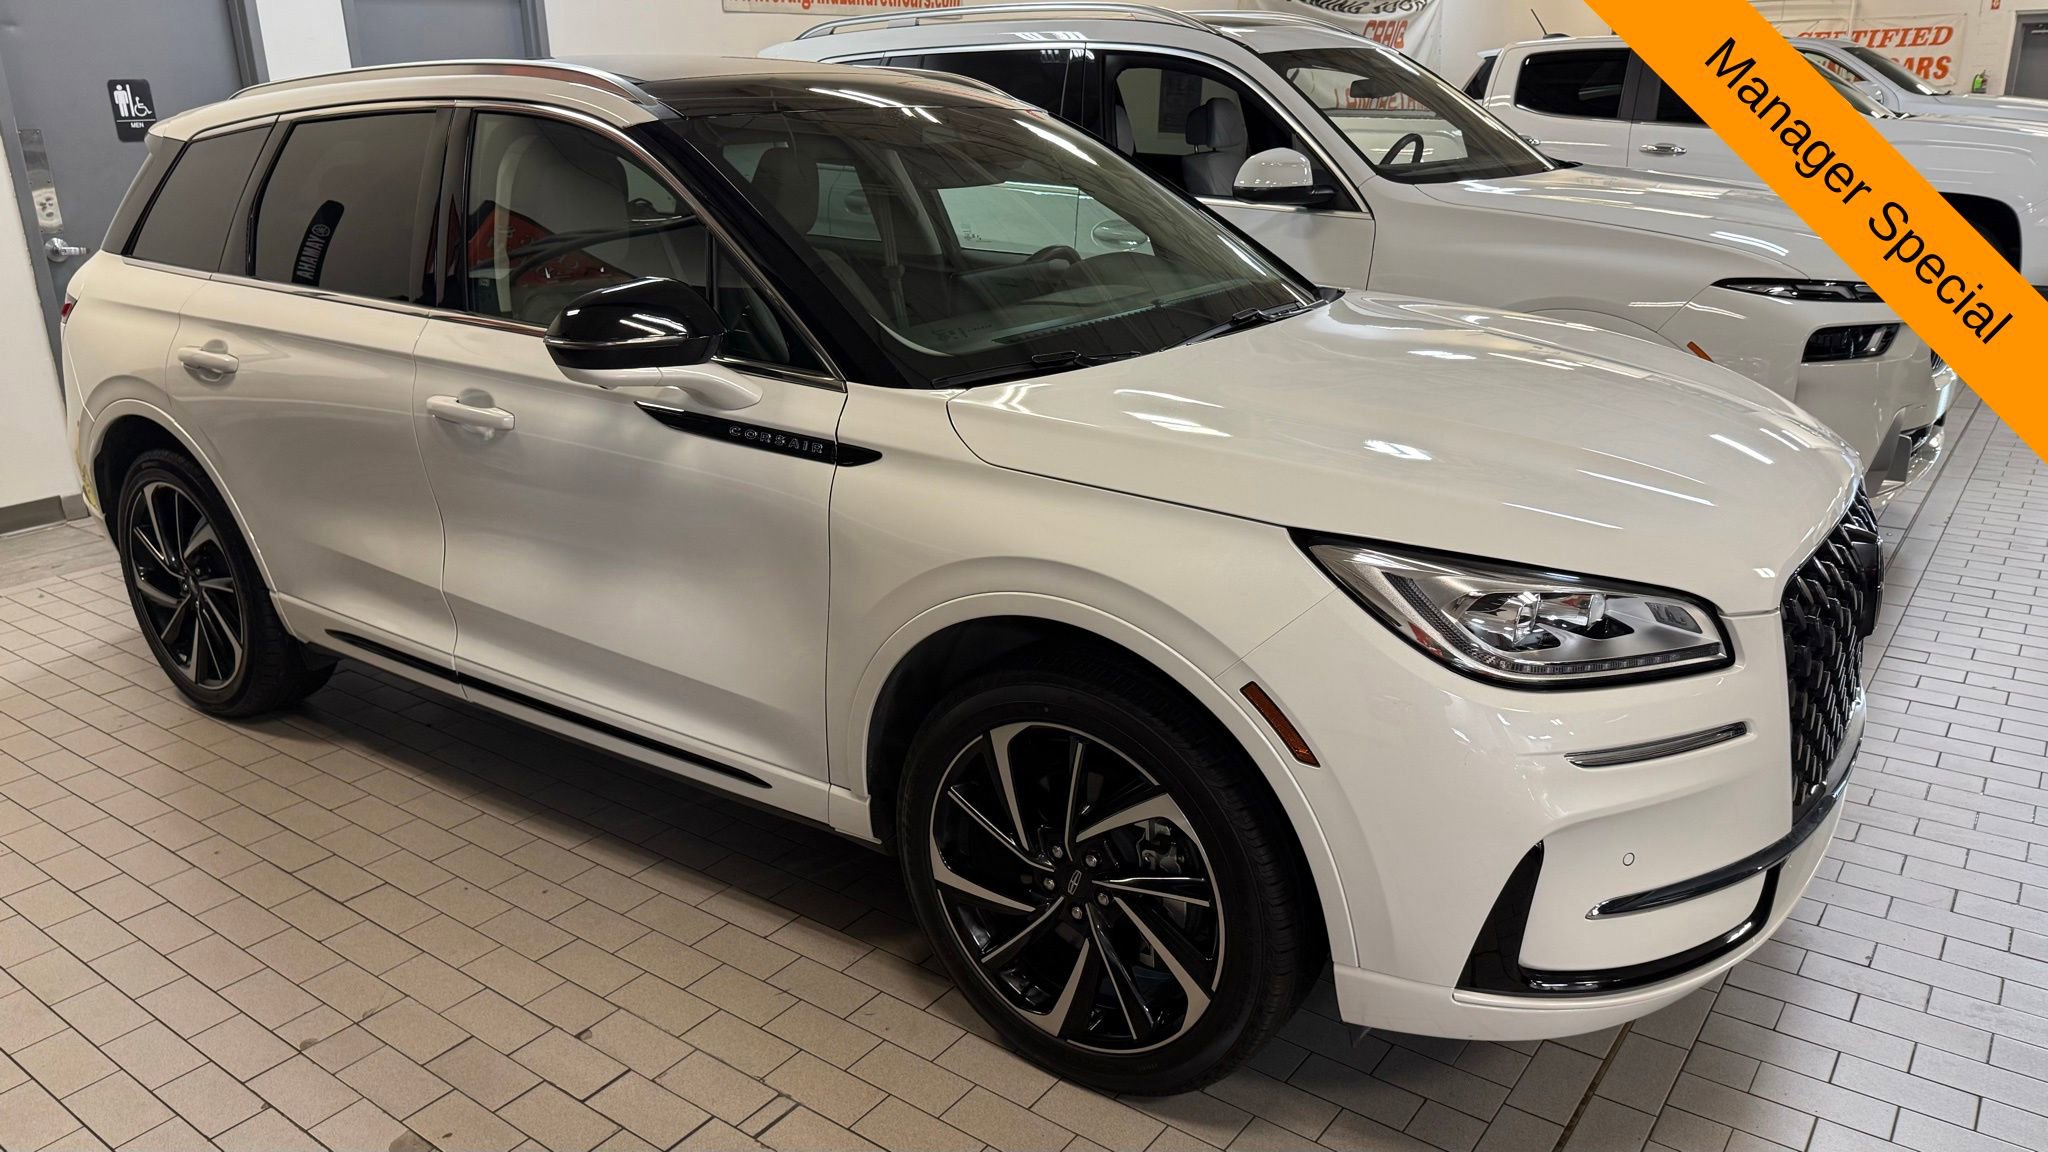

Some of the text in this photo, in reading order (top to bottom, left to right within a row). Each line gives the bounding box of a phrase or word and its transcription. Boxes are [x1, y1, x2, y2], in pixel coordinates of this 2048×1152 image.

[1890, 56, 1952, 80] ARS
[130, 121, 145, 129] MEN
[729, 425, 824, 454] CORSAIR
